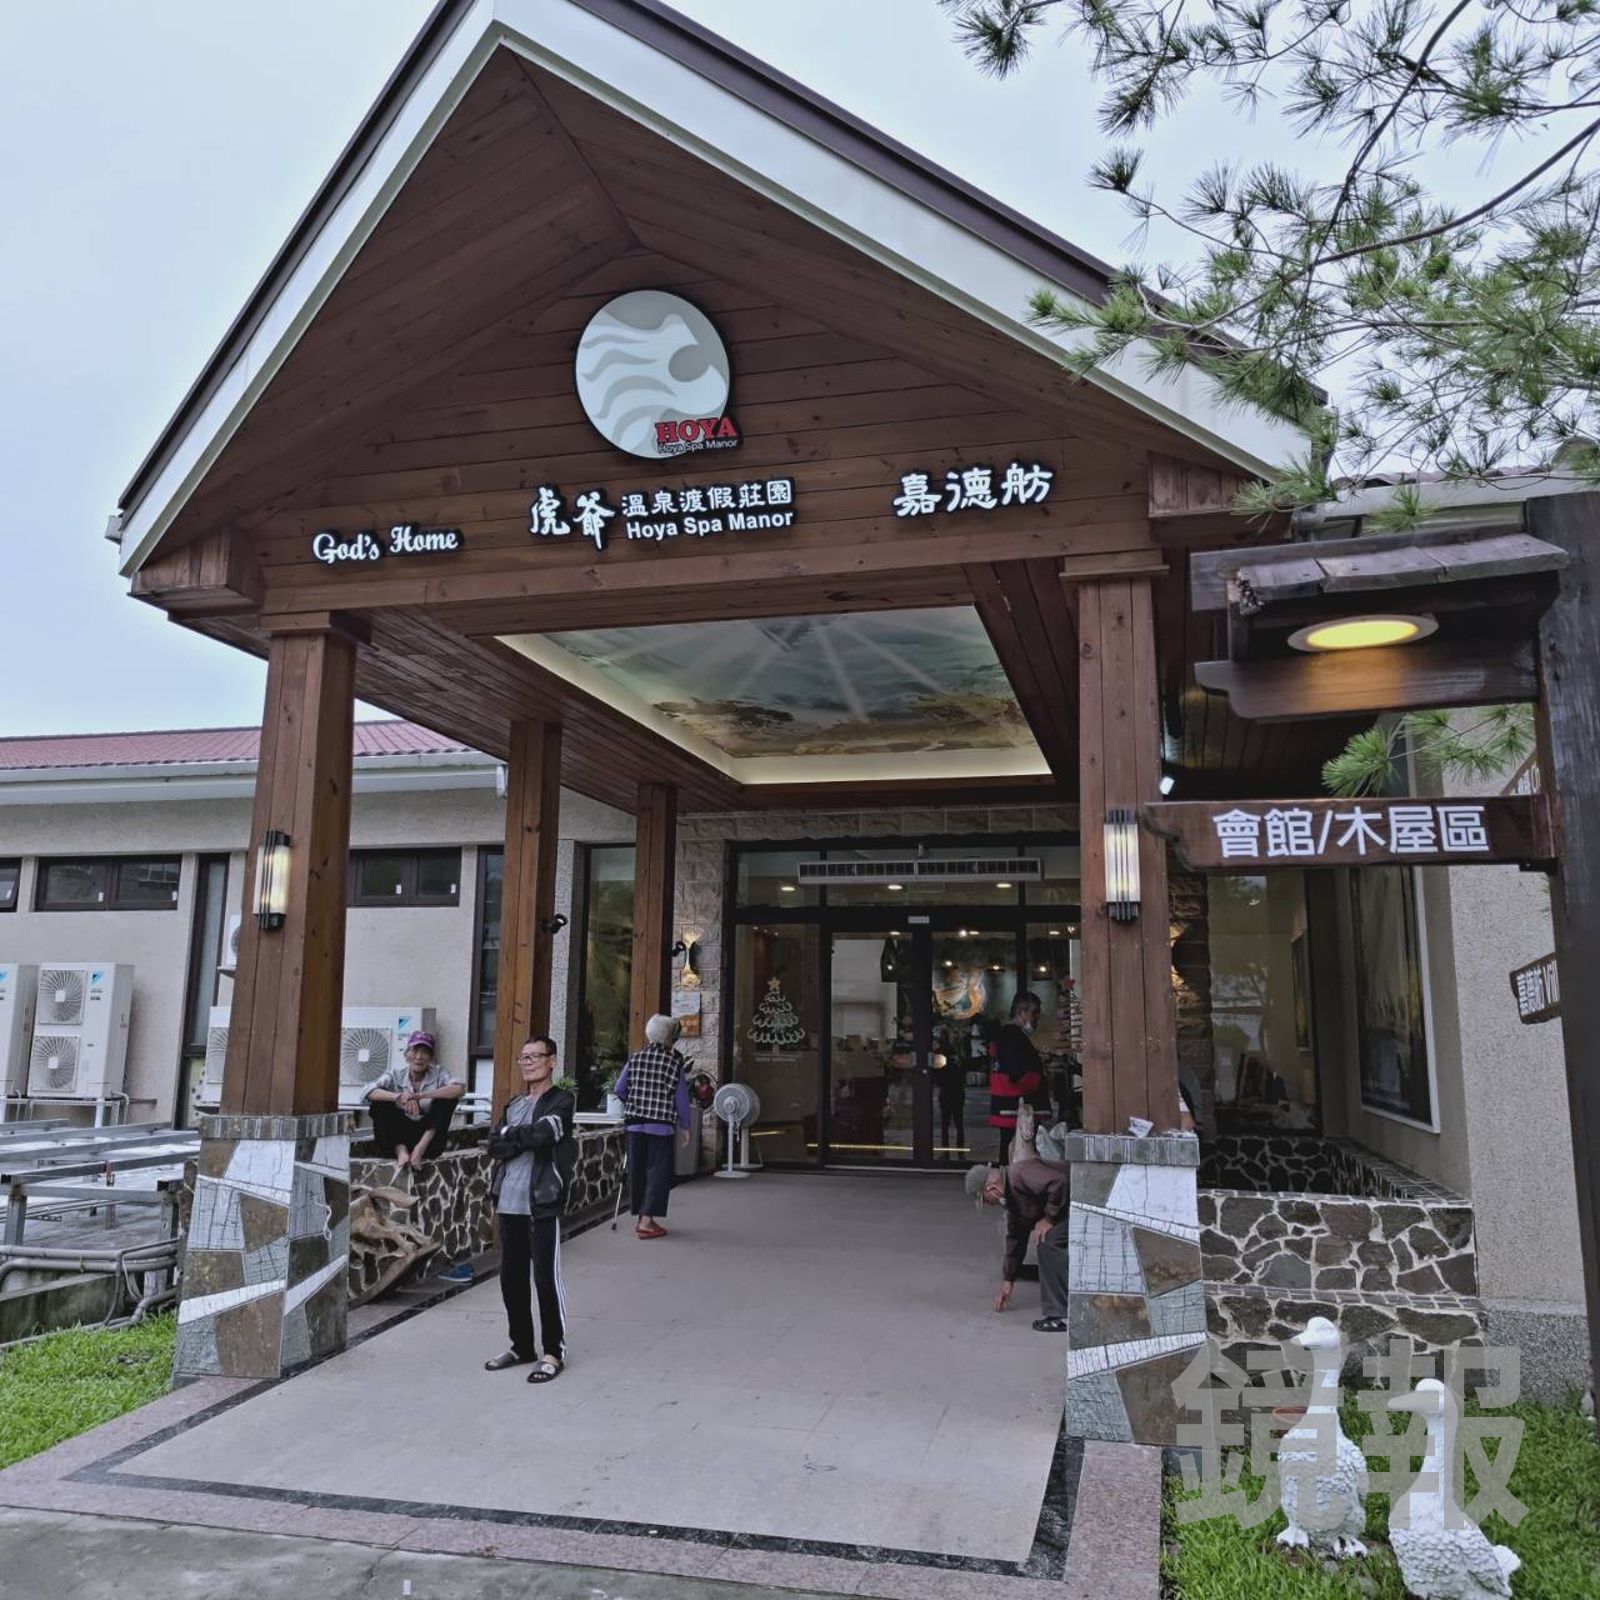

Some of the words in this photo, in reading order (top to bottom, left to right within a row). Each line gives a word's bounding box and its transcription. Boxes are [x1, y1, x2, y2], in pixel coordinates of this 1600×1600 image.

[655, 417, 738, 444] HOYA
[658, 443, 685, 455] Hoya
[685, 440, 704, 453] Spa
[705, 440, 738, 450] Manor
[893, 462, 1053, 517] 嘉德舫
[530, 487, 615, 549] 虎爺
[621, 479, 792, 518] 溫泉渡假莊園
[626, 521, 678, 541] Hoya
[684, 516, 723, 537] Spa
[729, 511, 793, 531] Manor
[313, 533, 380, 564] God's
[390, 525, 458, 553] Home
[1212, 806, 1489, 858] 會館/木屋區
